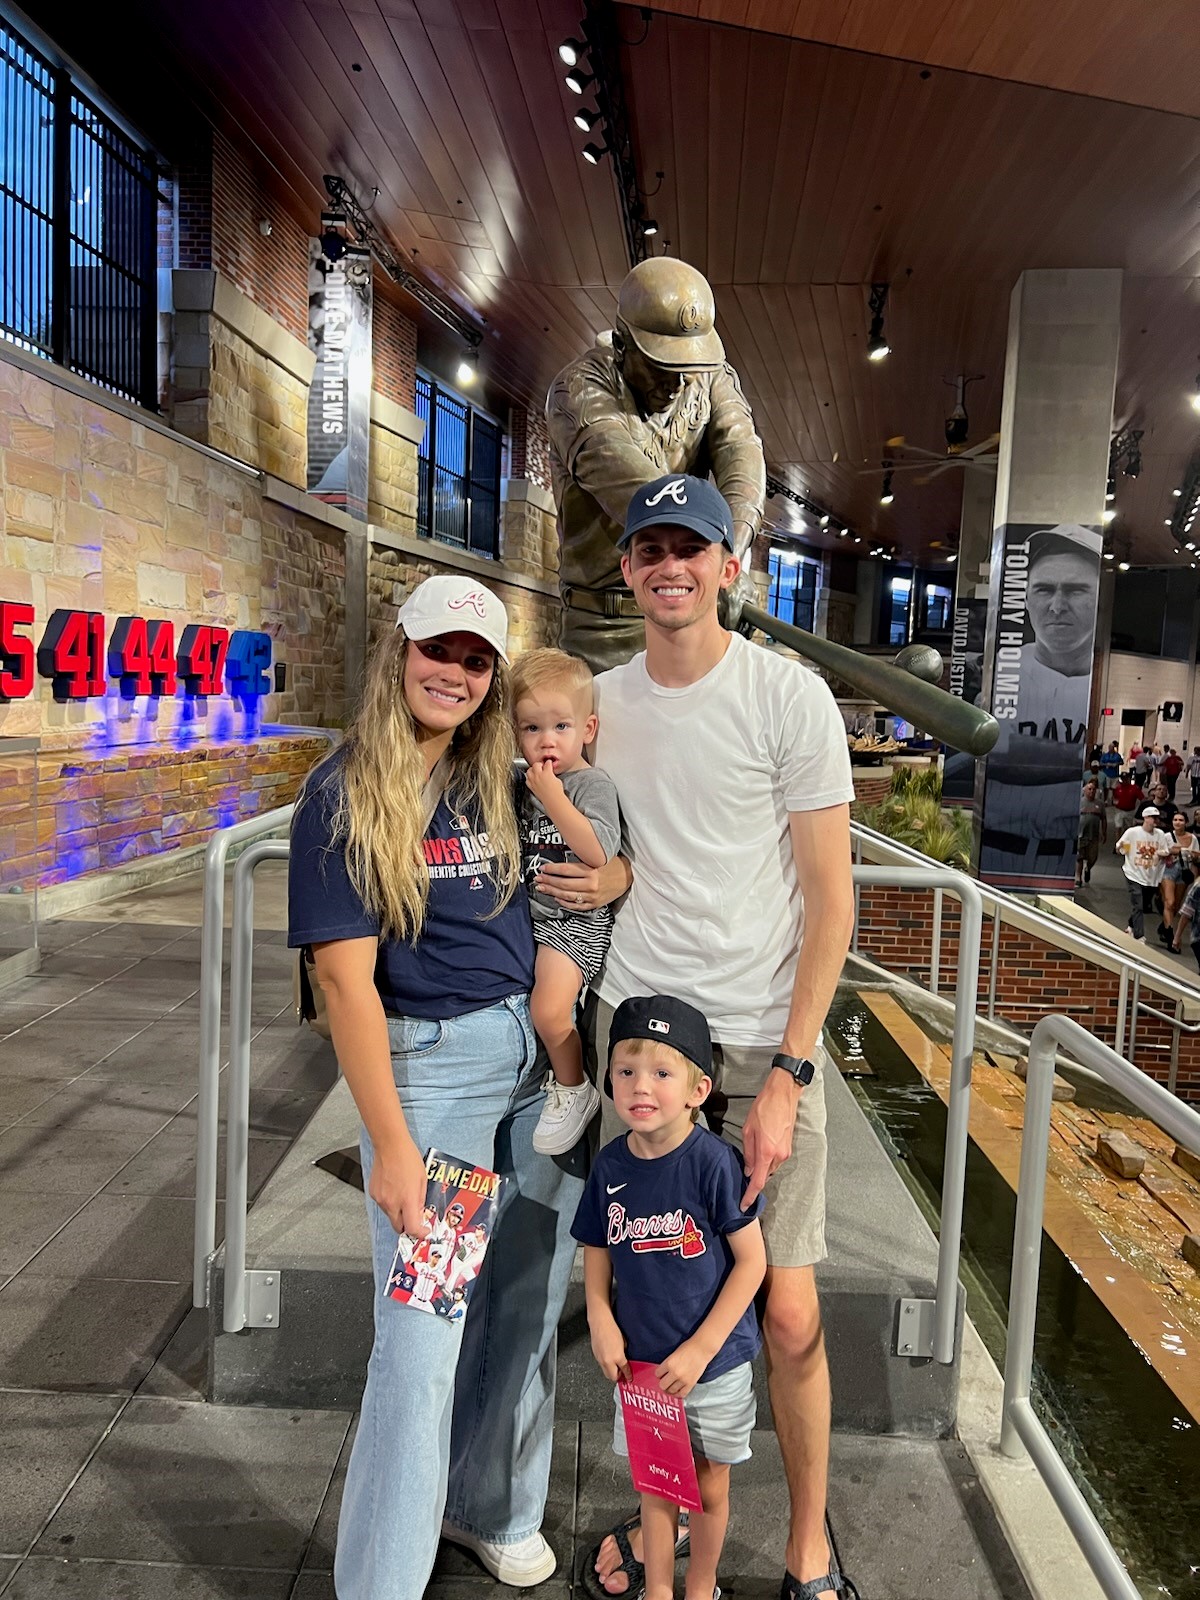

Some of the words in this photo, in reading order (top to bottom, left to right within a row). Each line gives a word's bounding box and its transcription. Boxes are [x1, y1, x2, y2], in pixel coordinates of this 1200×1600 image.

[325, 257, 346, 323] EDDIE
[322, 330, 345, 434] MATHEWS
[1001, 541, 1031, 625] TOMMY
[953, 607, 970, 647] DAVID
[50, 610, 107, 698] 41
[118, 616, 177, 696] 44
[185, 625, 229, 696] 47
[949, 649, 966, 700] JUSTIC
[994, 631, 1024, 720] HOLMES
[428, 865, 457, 879] HENTIC
[426, 1160, 502, 1198] GAMEDAY
[607, 1202, 683, 1246] Braves
[623, 1390, 680, 1422] INTERNET
